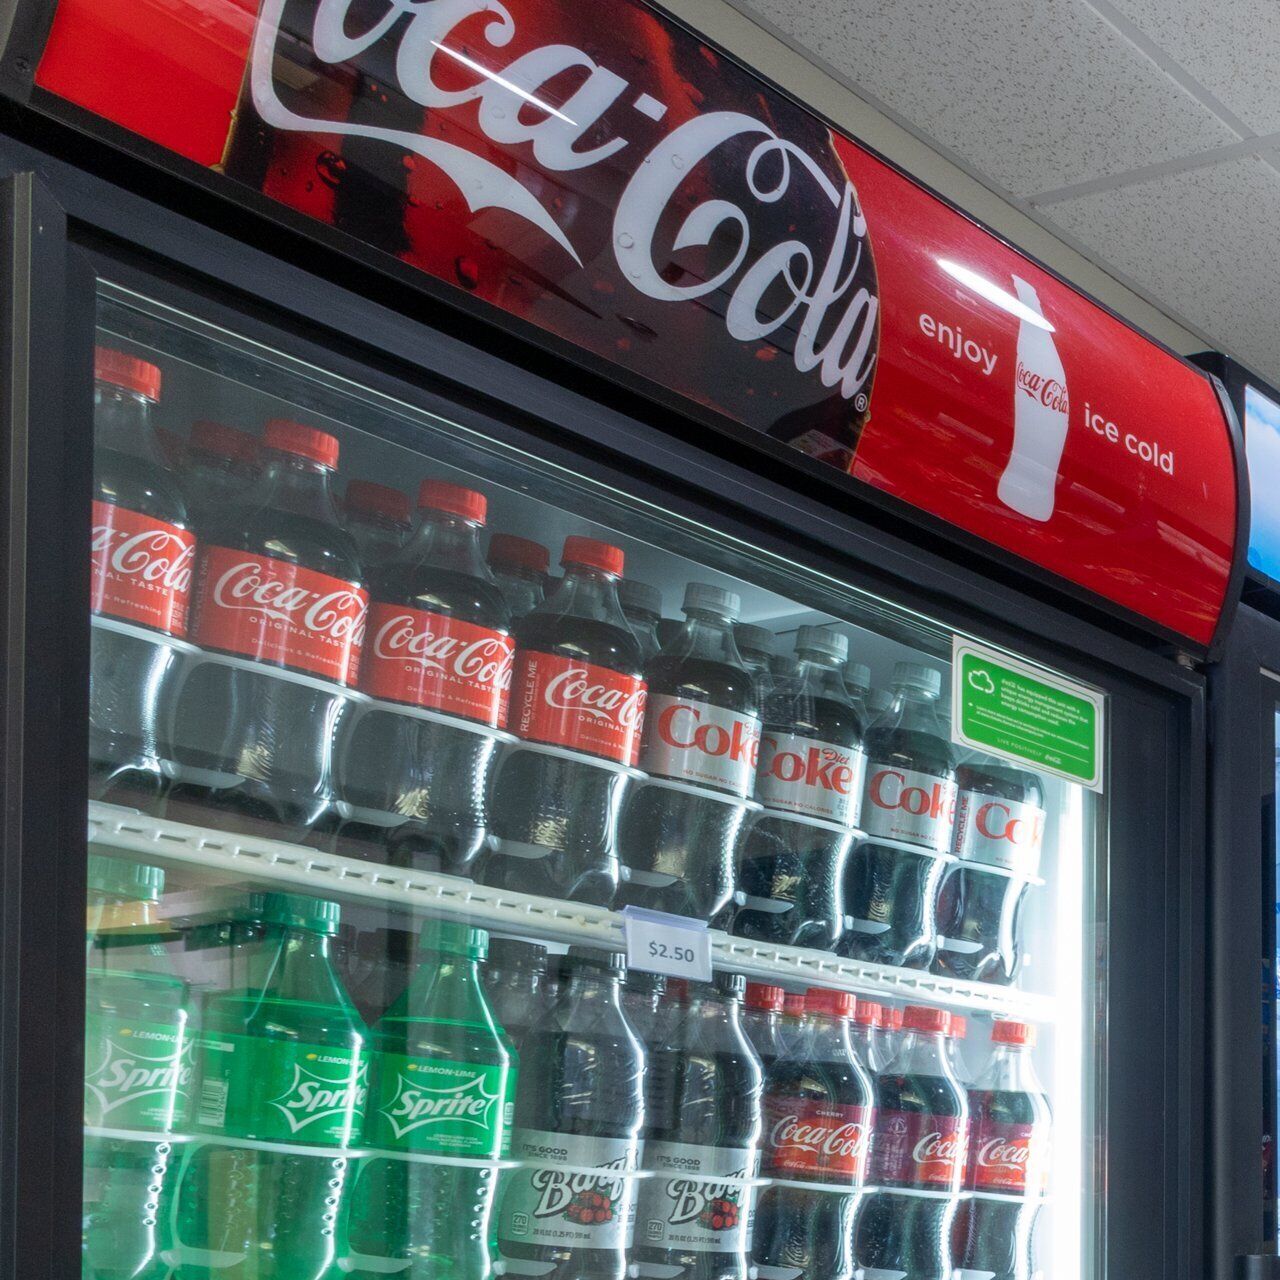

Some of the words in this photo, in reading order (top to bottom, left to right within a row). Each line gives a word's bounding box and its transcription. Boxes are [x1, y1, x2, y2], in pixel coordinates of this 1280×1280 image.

[919, 314, 997, 375] enjoy
[1017, 361, 1069, 415] Coca-Cola
[1085, 402, 1118, 443] ice
[1125, 433, 1174, 475] cold
[214, 563, 367, 646] Coca-Cola
[249, 616, 313, 640] ORIGINAL
[374, 615, 515, 691] Coca-Cola
[405, 665, 462, 685] ORIGINAL
[520, 682, 536, 732] RECYCLE
[529, 660, 538, 679] ME
[649, 941, 694, 963] $2.50
[418, 1064, 475, 1079] LEMON-LIME
[391, 1090, 485, 1117] Sprite
[815, 1109, 844, 1118] CHERRY
